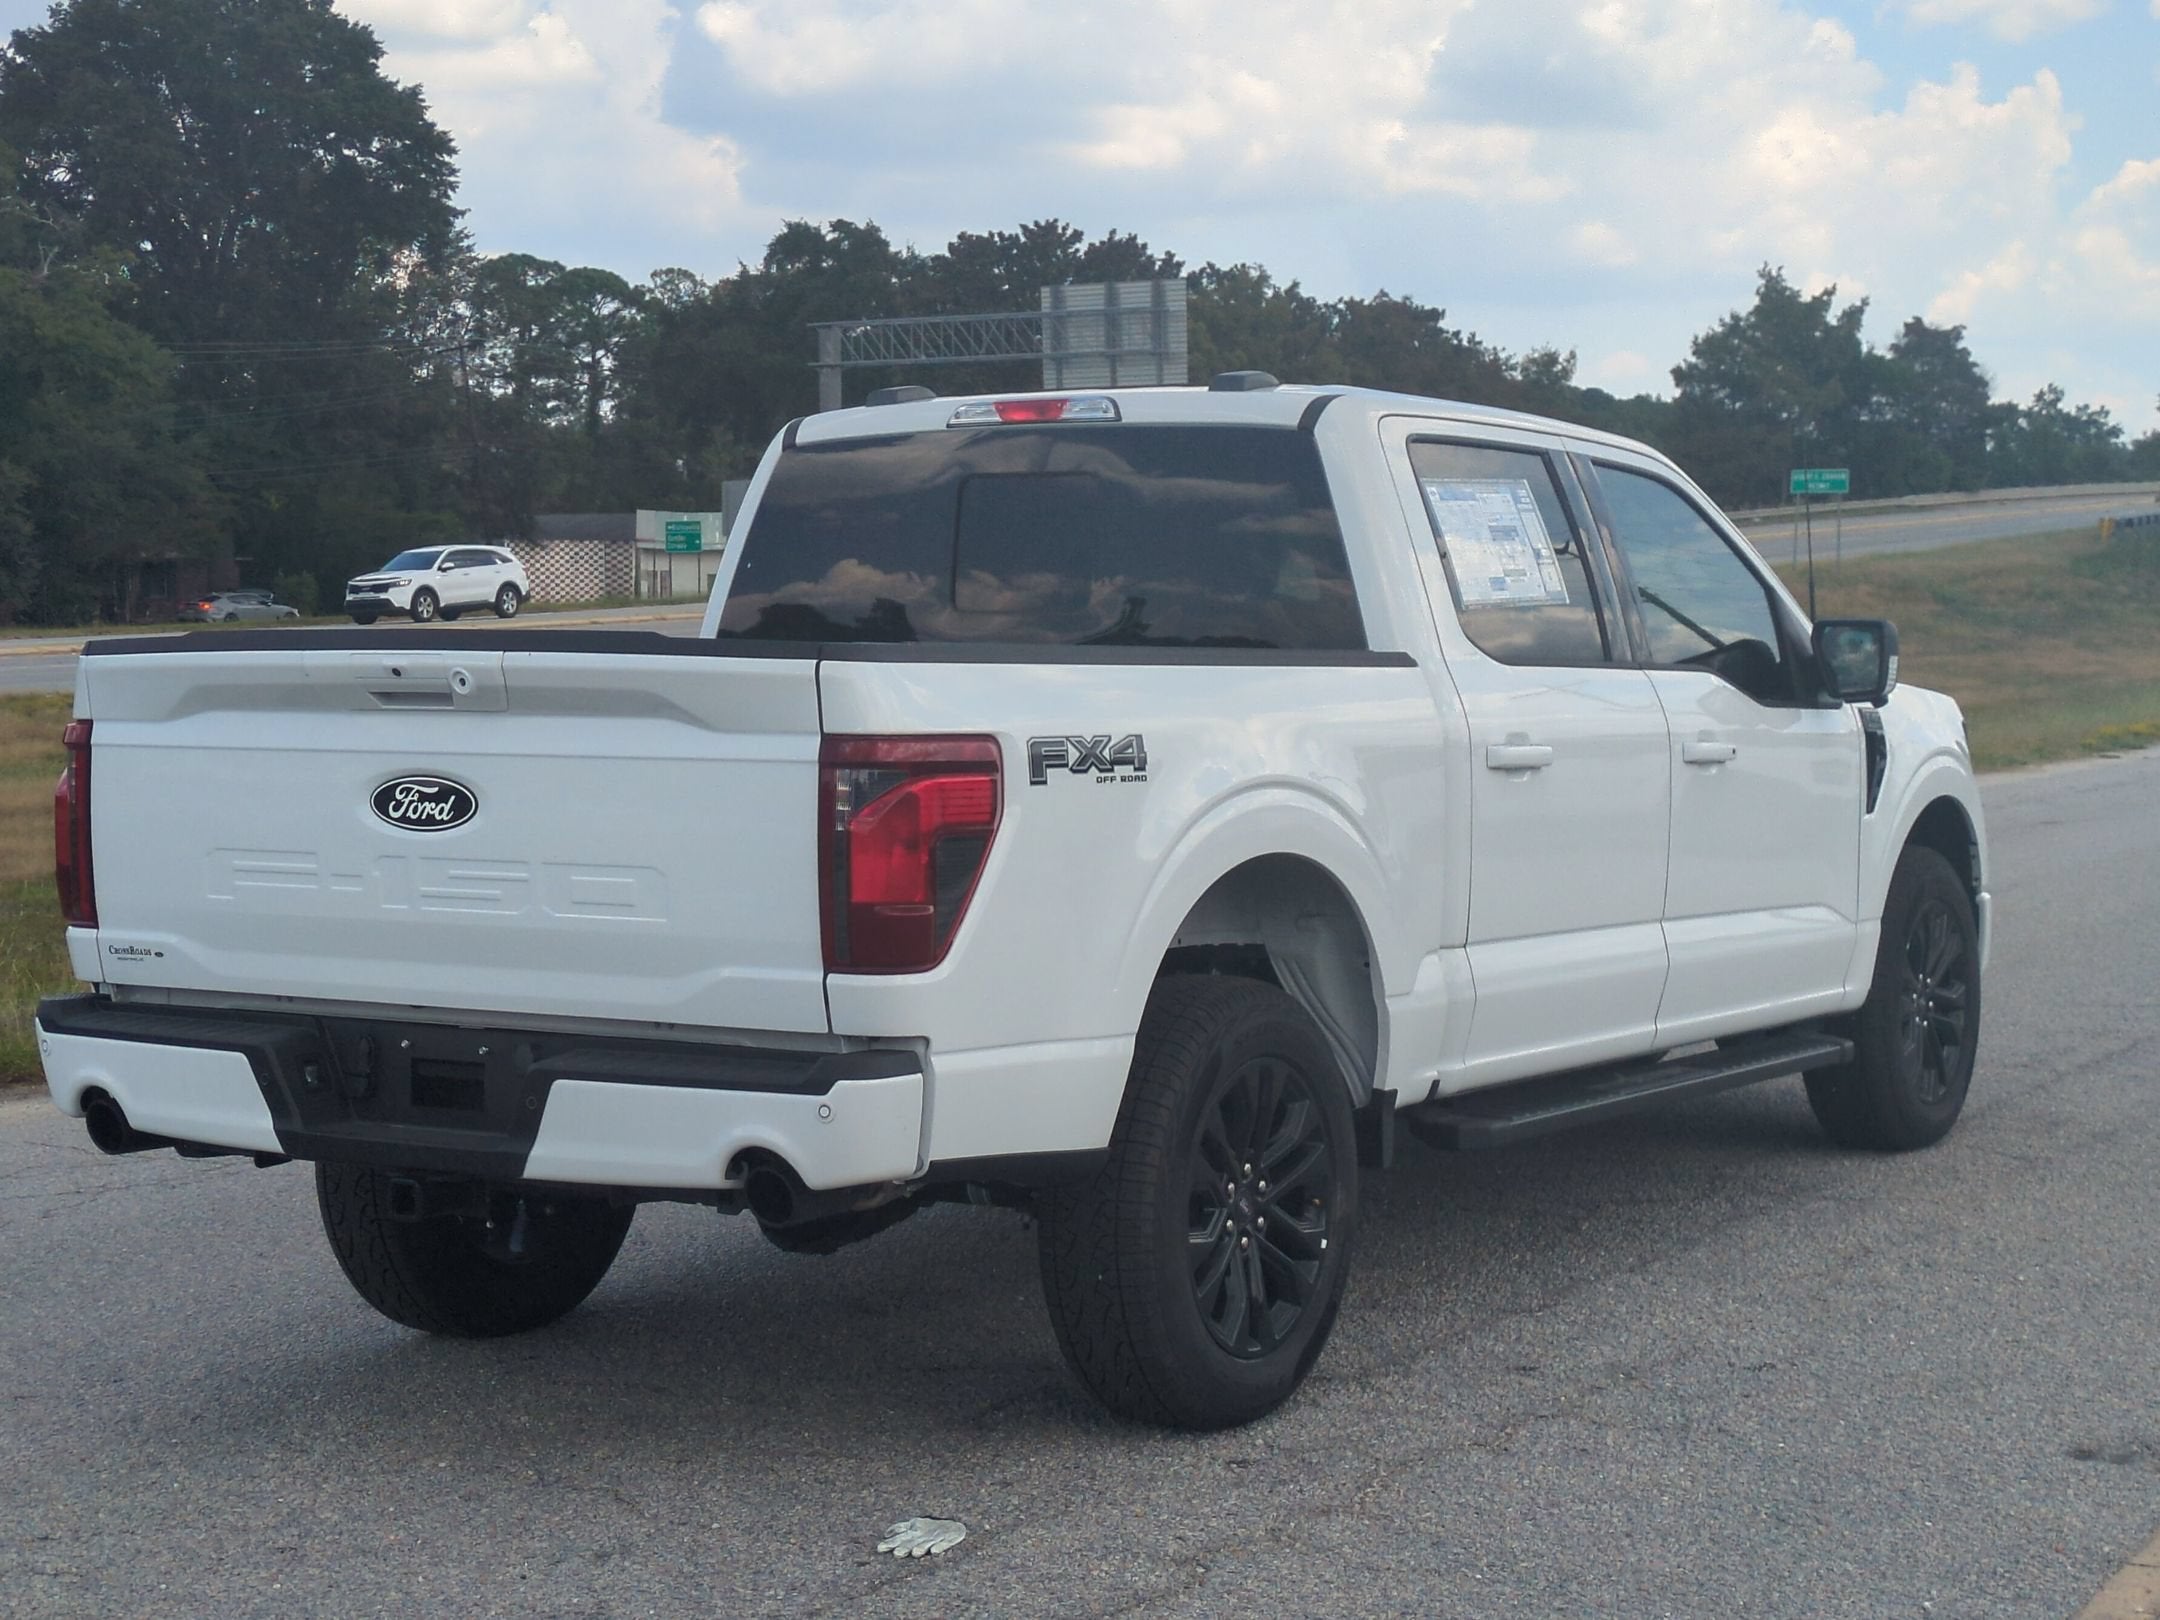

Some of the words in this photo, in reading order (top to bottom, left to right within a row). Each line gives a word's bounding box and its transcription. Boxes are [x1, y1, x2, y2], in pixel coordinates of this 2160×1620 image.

[1027, 734, 1147, 785] FX4
[1096, 775, 1117, 783] OFF
[1120, 774, 1148, 783] ROAD
[388, 784, 456, 821] Ford
